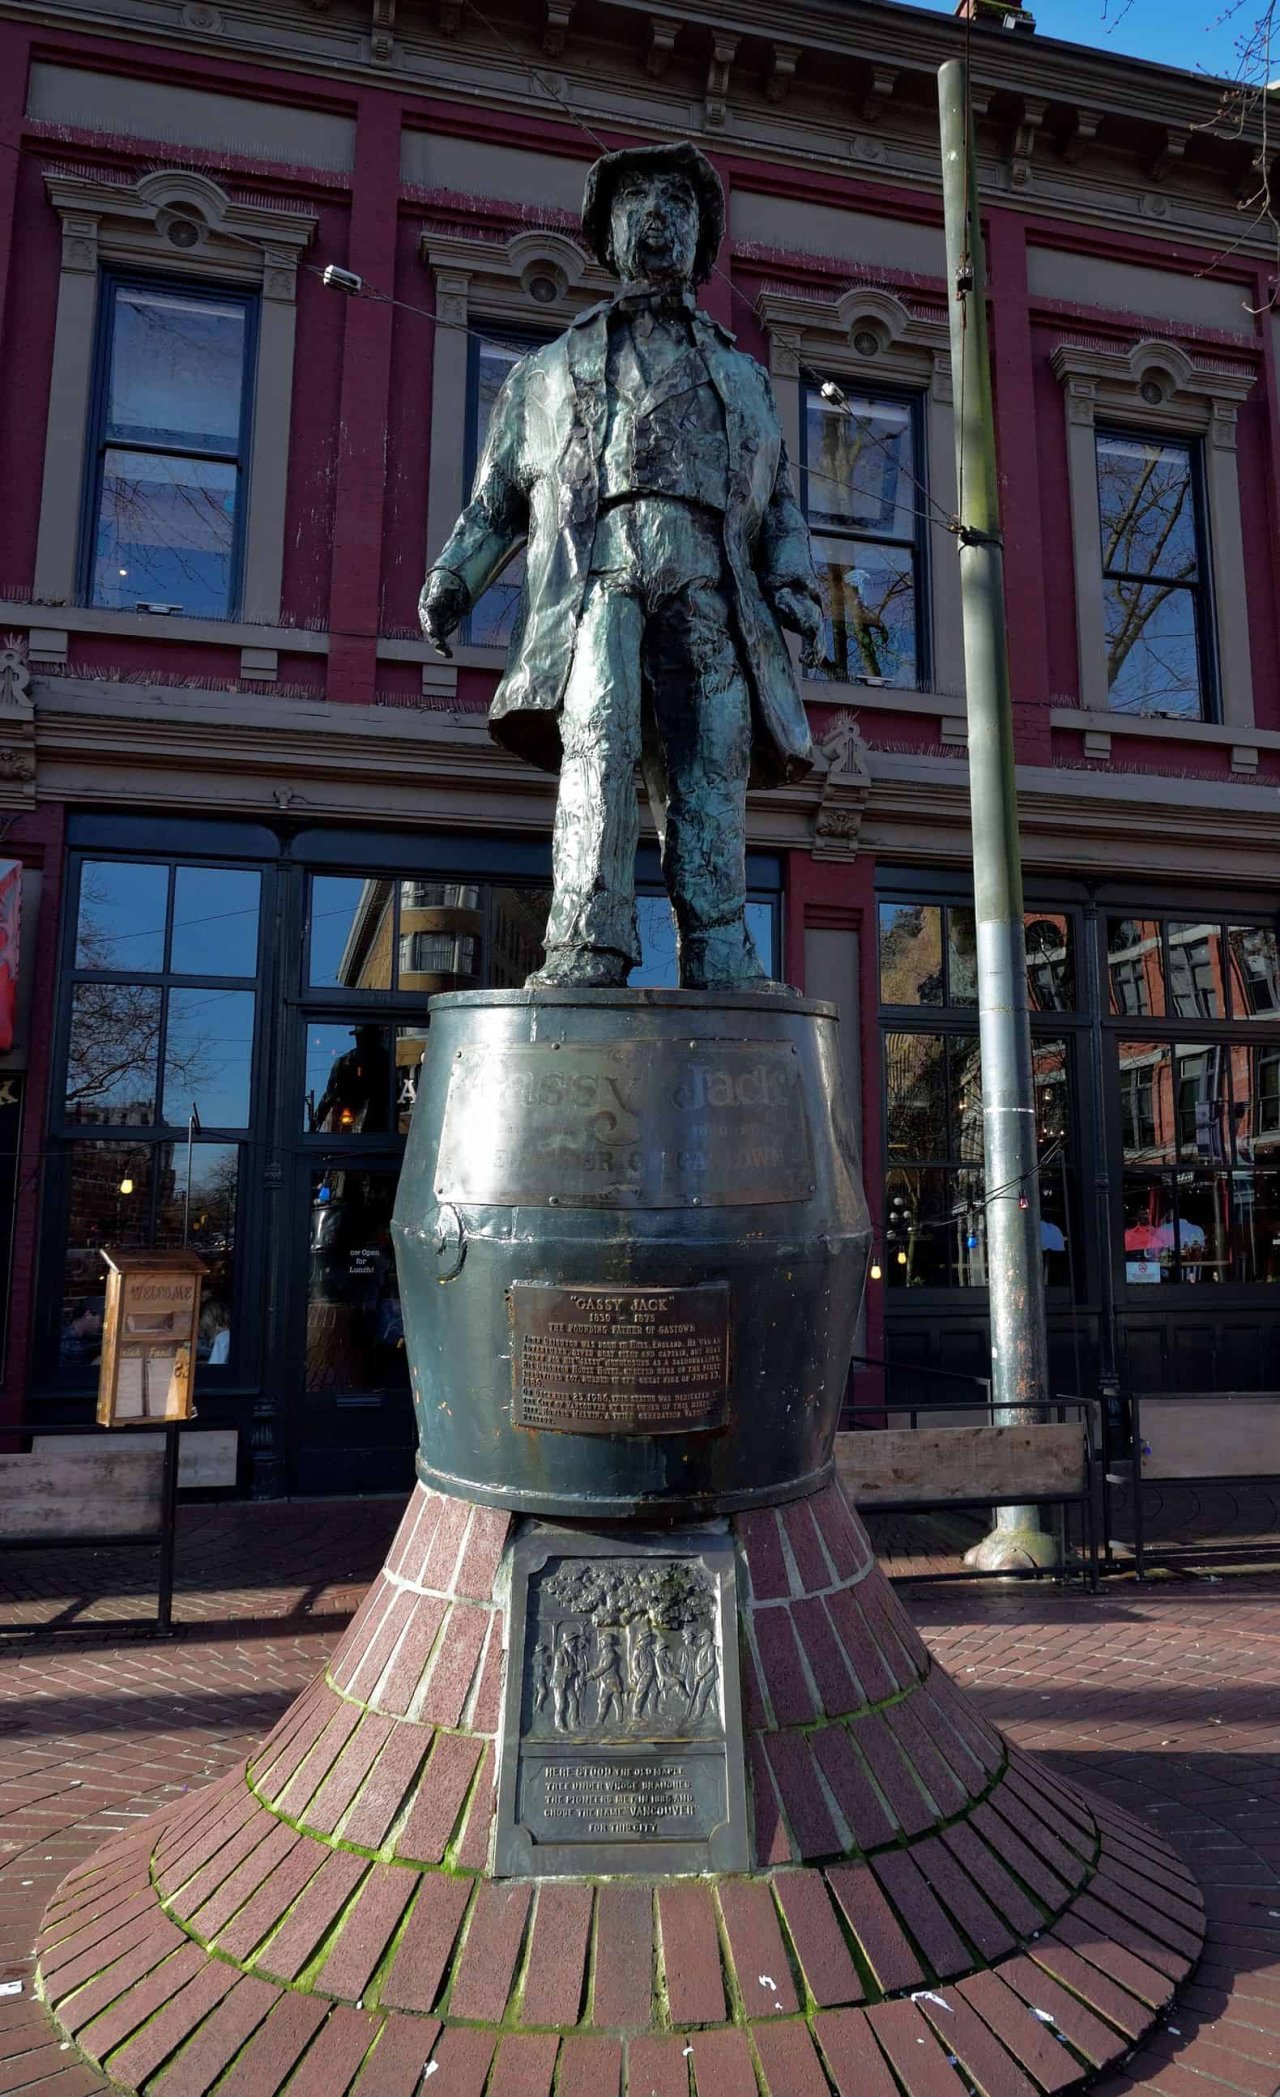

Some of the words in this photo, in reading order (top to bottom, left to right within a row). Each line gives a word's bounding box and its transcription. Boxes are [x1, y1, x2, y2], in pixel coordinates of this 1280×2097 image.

[361, 1249, 380, 1257] Open
[356, 1257, 368, 1265] for
[349, 1265, 375, 1274] Lunch!
[131, 1285, 192, 1301] WELCOME
[570, 1296, 623, 1312] "GASSY
[631, 1295, 675, 1312] JACK"
[589, 1313, 611, 1323] 1830
[634, 1313, 656, 1323] 1875
[549, 1322, 565, 1332] THE
[567, 1323, 608, 1334] FOUNDING
[611, 1325, 643, 1335] FATHER
[645, 1325, 656, 1335] OF
[659, 1324, 695, 1334] GASTOWN
[545, 1766, 575, 1778] HERE
[576, 1766, 613, 1778] STOOD
[614, 1768, 631, 1777] THE
[545, 1781, 572, 1791] TREE
[572, 1781, 604, 1791] UNDER
[545, 1795, 564, 1804] THE
[565, 1795, 614, 1805] PIONEERS
[544, 1807, 573, 1818] CHOSE
[577, 1808, 596, 1818] THE
[588, 1823, 608, 1833] FOR
[610, 1823, 632, 1833] THIS
